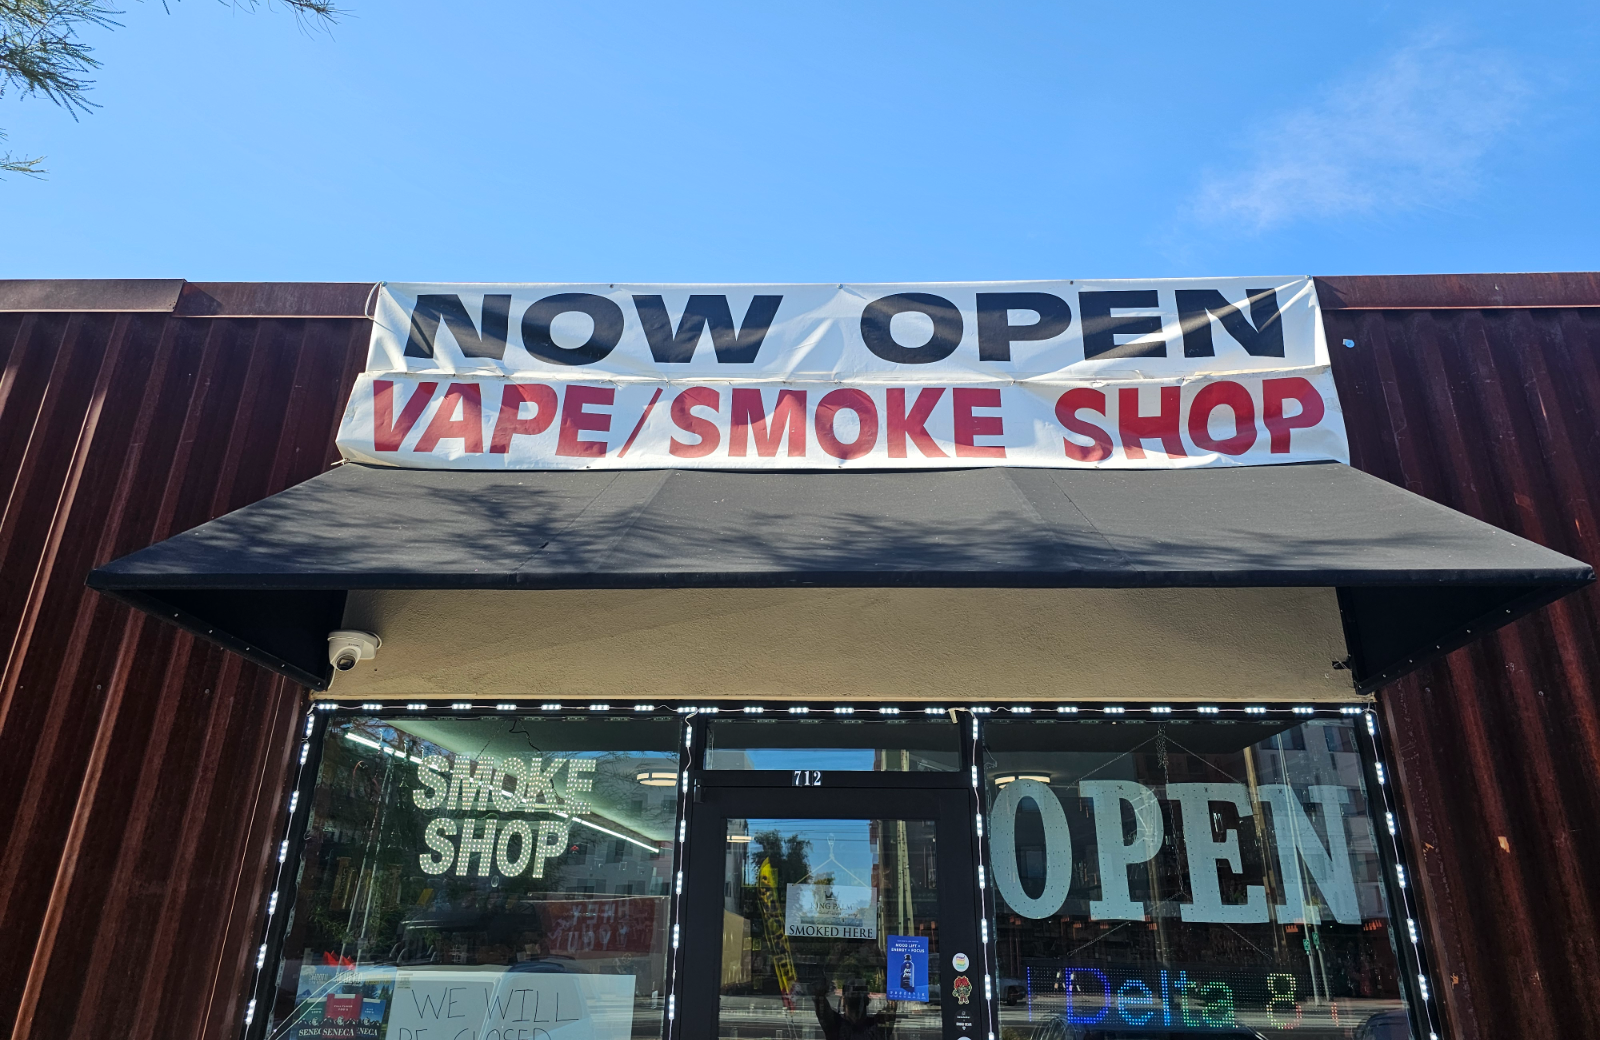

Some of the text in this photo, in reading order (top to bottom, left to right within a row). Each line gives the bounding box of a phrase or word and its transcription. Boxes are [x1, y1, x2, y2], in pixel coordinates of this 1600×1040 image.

[403, 288, 1286, 366] NOW OPEN
[372, 376, 1326, 462] VAPE/SMOKE SHOP
[412, 754, 597, 815] SMOKE
[793, 770, 822, 786] 712
[418, 817, 570, 879] SHOP
[990, 778, 1362, 926] OPEN
[789, 925, 873, 939] SMOKED HERE
[411, 987, 580, 1023] WE WILL
[1065, 966, 1302, 1030] Delta 8
[322, 1027, 355, 1037] SENECA
[358, 1027, 378, 1036] NECA
